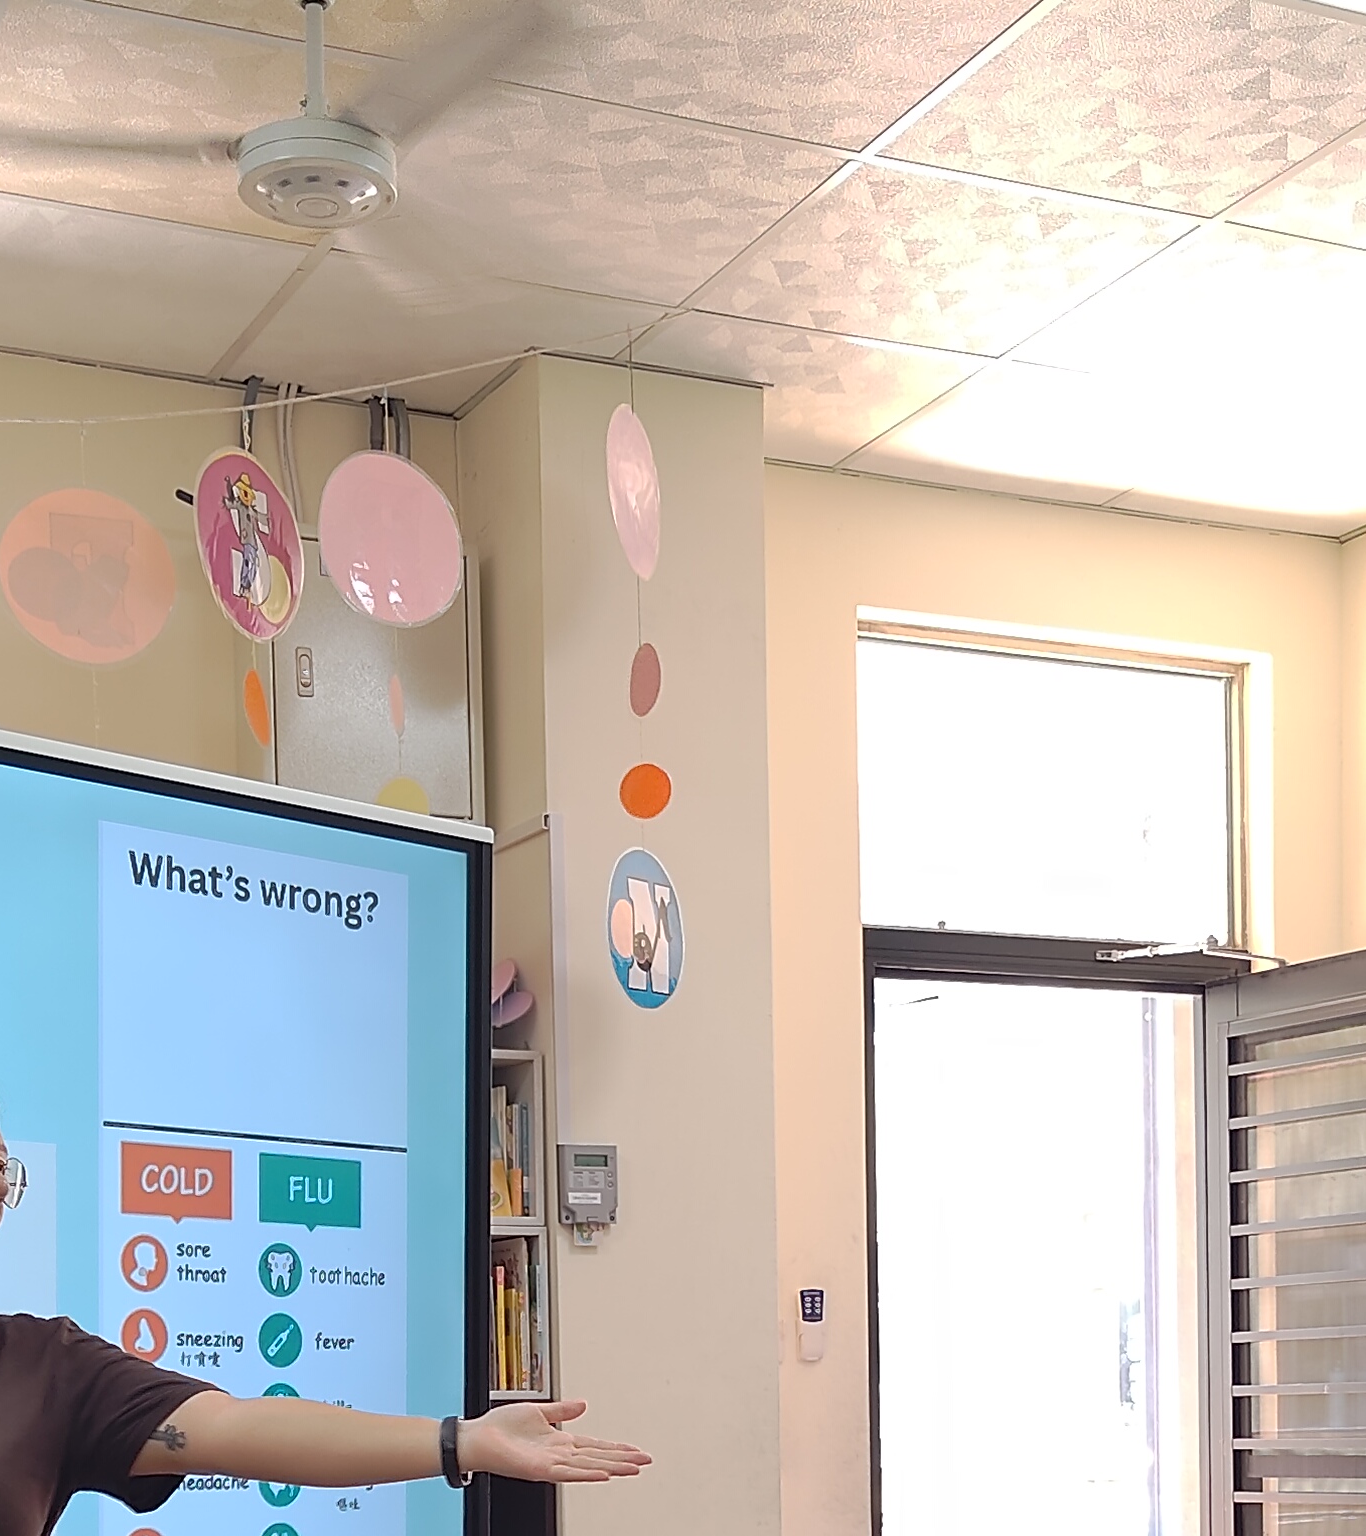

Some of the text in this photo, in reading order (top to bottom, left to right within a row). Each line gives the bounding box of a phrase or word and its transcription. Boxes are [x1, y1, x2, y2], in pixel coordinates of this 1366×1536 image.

[129, 850, 379, 930] What’s wrong?
[140, 1164, 214, 1197] COLD
[288, 1175, 334, 1206] FLU
[176, 1241, 212, 1259] sore
[176, 1265, 227, 1284] throat
[176, 1330, 244, 1353] sneezing
[315, 1333, 355, 1352] fever
